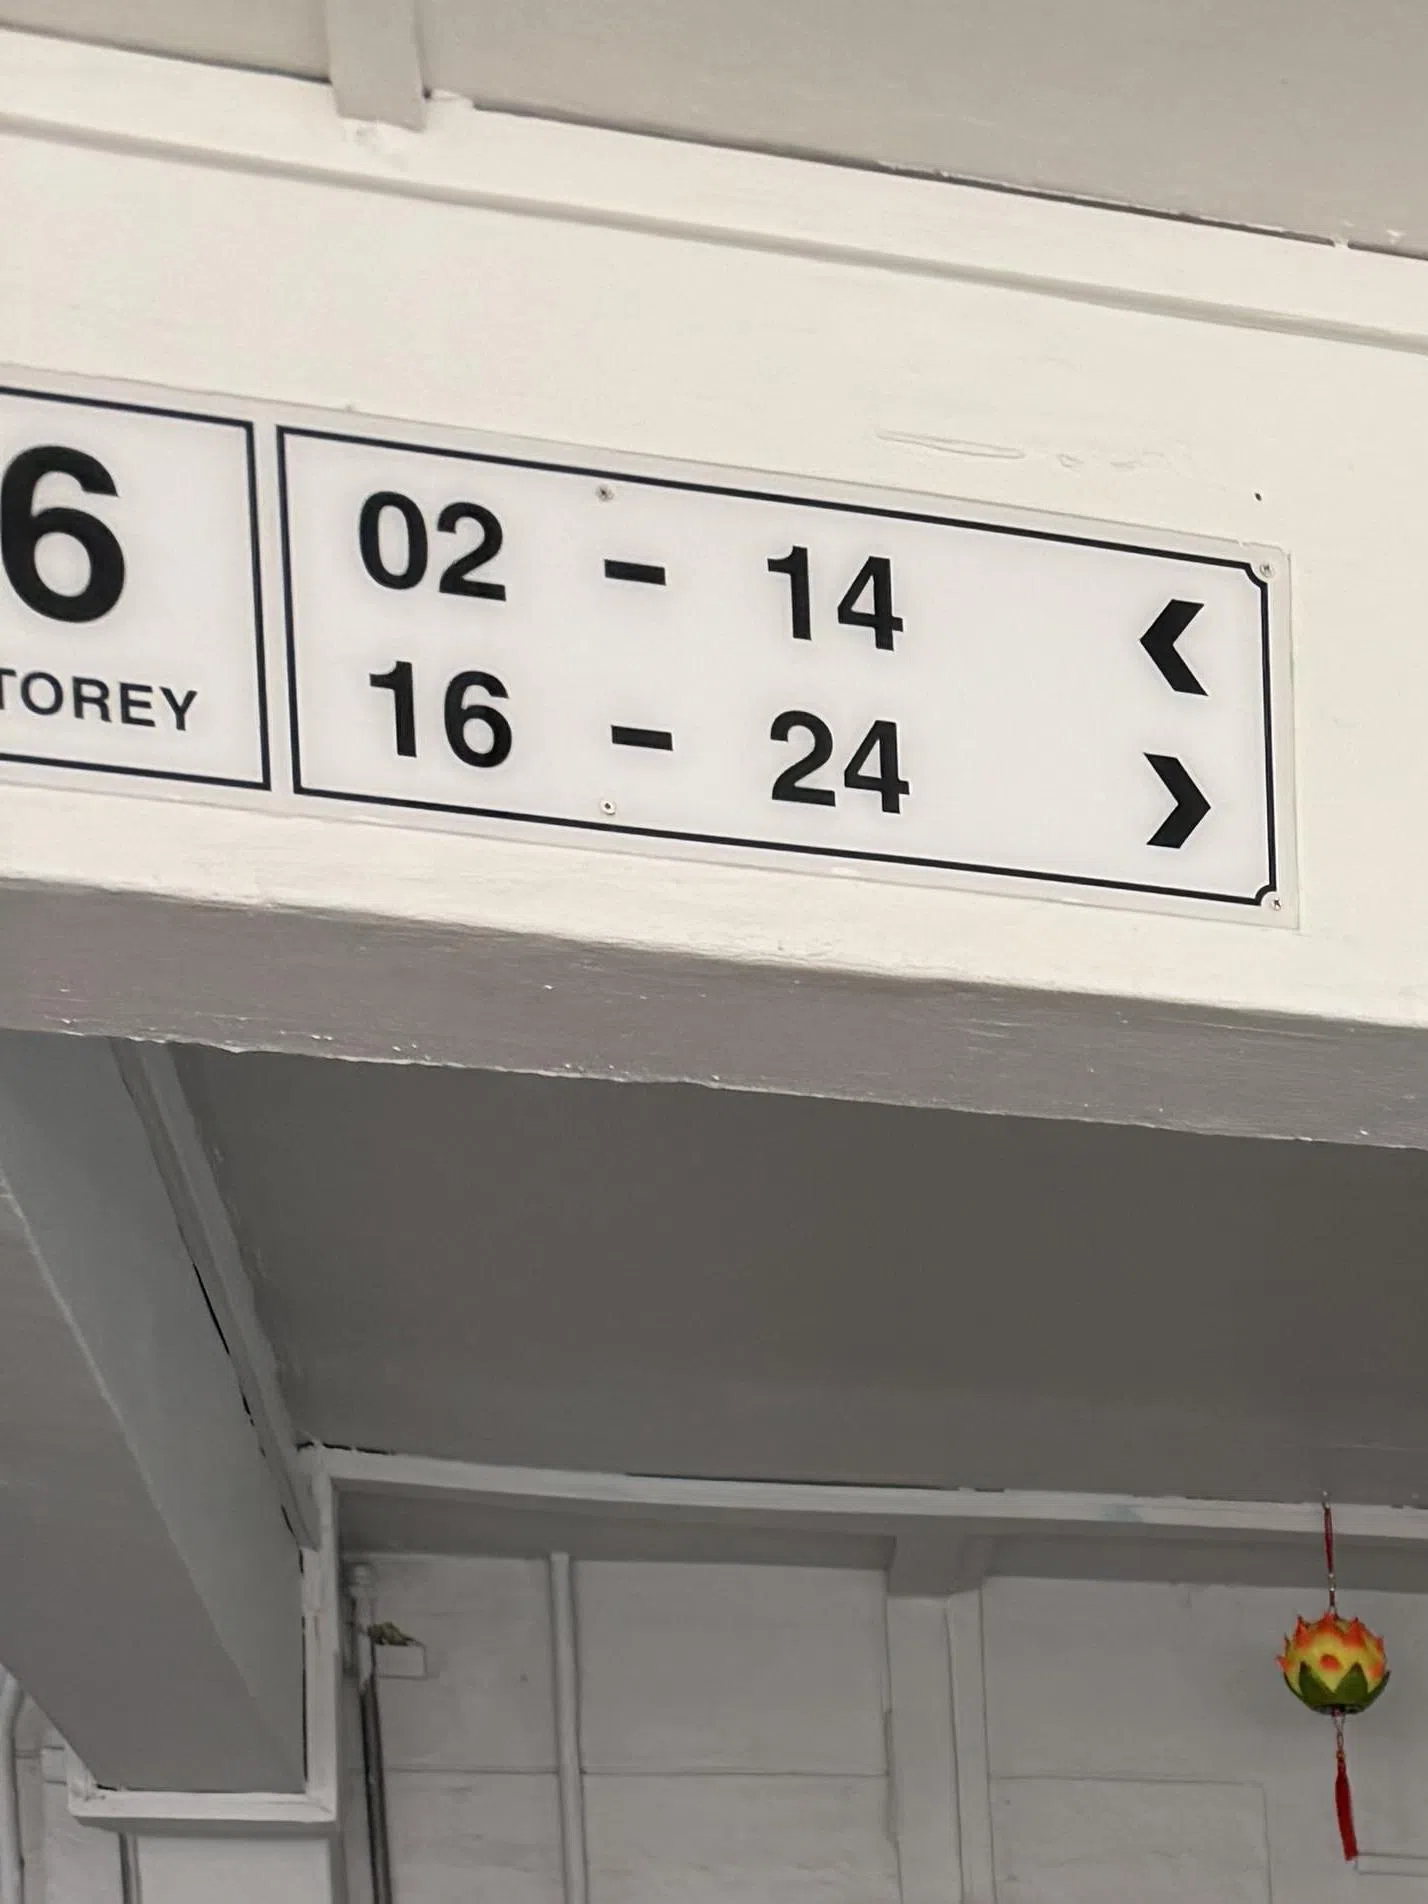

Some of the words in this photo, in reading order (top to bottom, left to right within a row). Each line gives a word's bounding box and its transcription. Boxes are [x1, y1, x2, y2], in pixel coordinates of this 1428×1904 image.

[0, 445, 125, 623] 6
[359, 491, 507, 602] 02
[766, 546, 905, 651] 14
[369, 661, 514, 768] 16
[769, 710, 910, 814] 24
